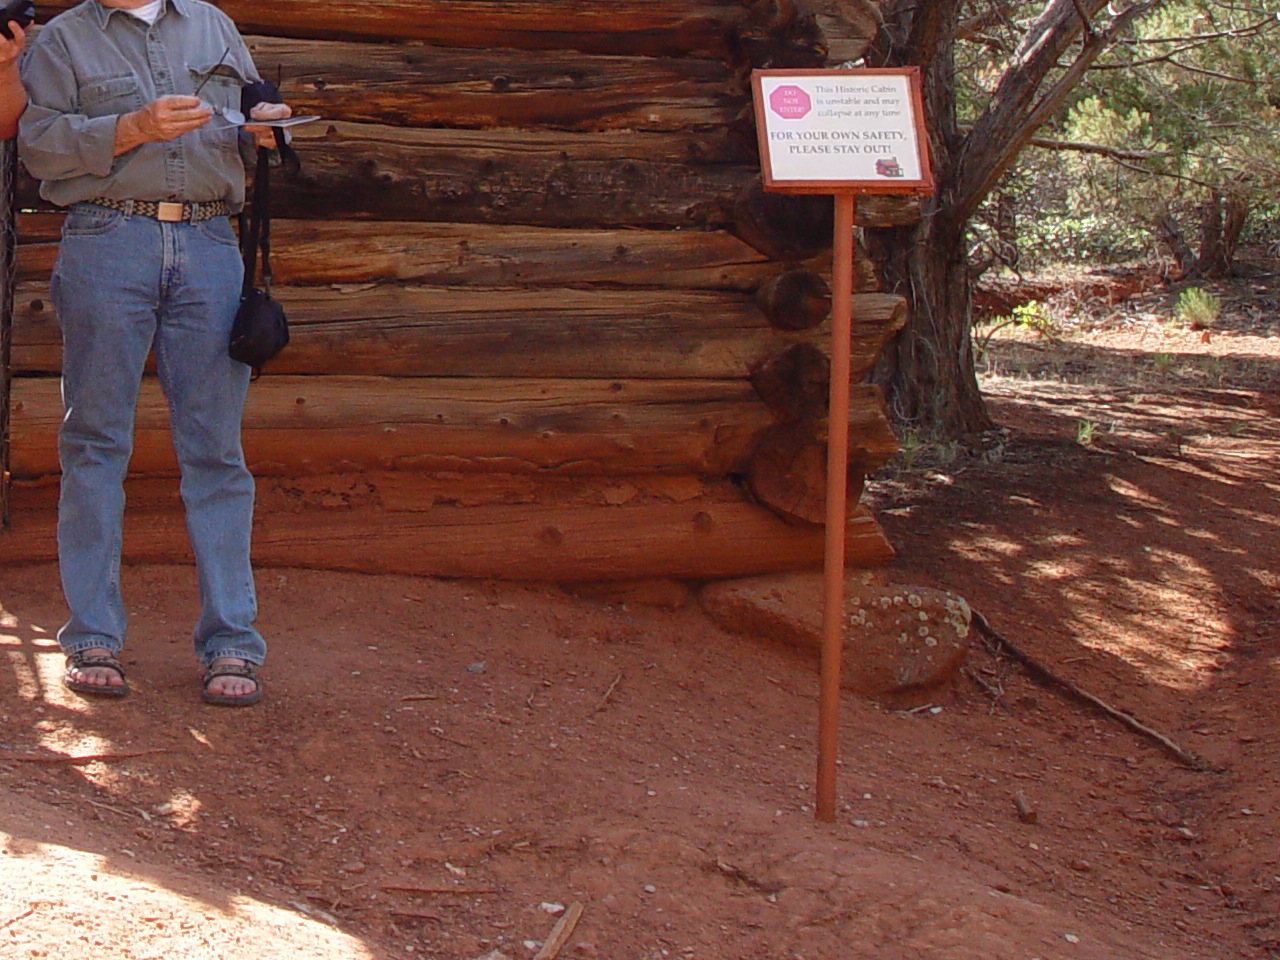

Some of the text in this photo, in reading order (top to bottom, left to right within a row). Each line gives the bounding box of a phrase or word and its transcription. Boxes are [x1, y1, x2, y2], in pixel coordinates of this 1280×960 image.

[815, 85, 897, 93] This Historic Cabin
[825, 97, 861, 105] unstable
[863, 97, 880, 105] and
[881, 98, 900, 107] may
[817, 109, 852, 118] collapse
[864, 110, 880, 118] any
[770, 131, 908, 141] FOR YOUR OWN SAFETY,
[789, 144, 892, 154] PLEASE STAY OUT!
